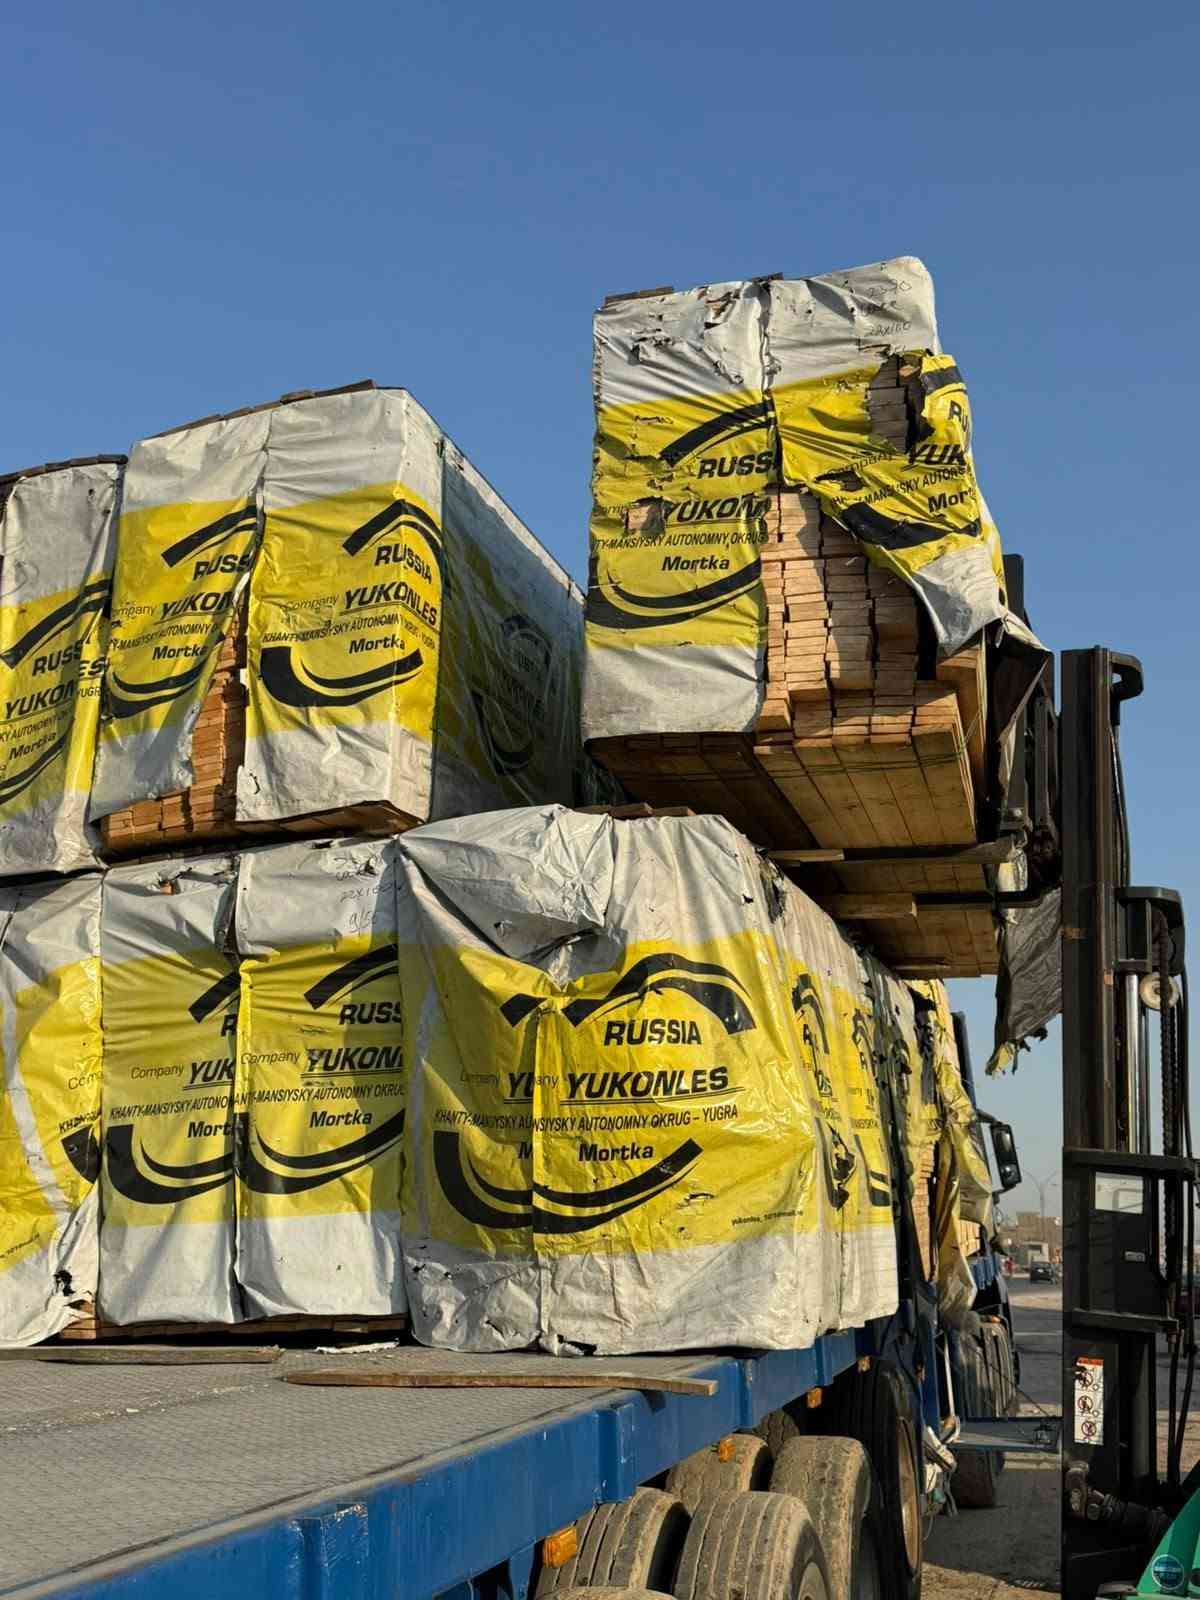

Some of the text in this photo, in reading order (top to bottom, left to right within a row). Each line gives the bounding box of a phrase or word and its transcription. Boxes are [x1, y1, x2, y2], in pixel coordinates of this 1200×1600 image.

[374, 543, 433, 585] RUSSIA
[661, 554, 730, 571] Mortka
[343, 580, 438, 627] YUKONLES
[348, 633, 406, 654] Mortka
[604, 1018, 702, 1046] RUSSIA
[240, 1050, 300, 1066] Company
[131, 1064, 185, 1079] Company
[313, 1084, 374, 1101] AUTONOMNY
[567, 1065, 730, 1100] YUKONLES
[109, 1099, 193, 1121] KHANTY-MANSIYSKY
[309, 1108, 373, 1129] Mortka
[577, 1114, 649, 1132] AUTONOMNY
[650, 1110, 691, 1128] OKRUG
[702, 1103, 739, 1123] YUGRA
[578, 1142, 654, 1162] Mortka
